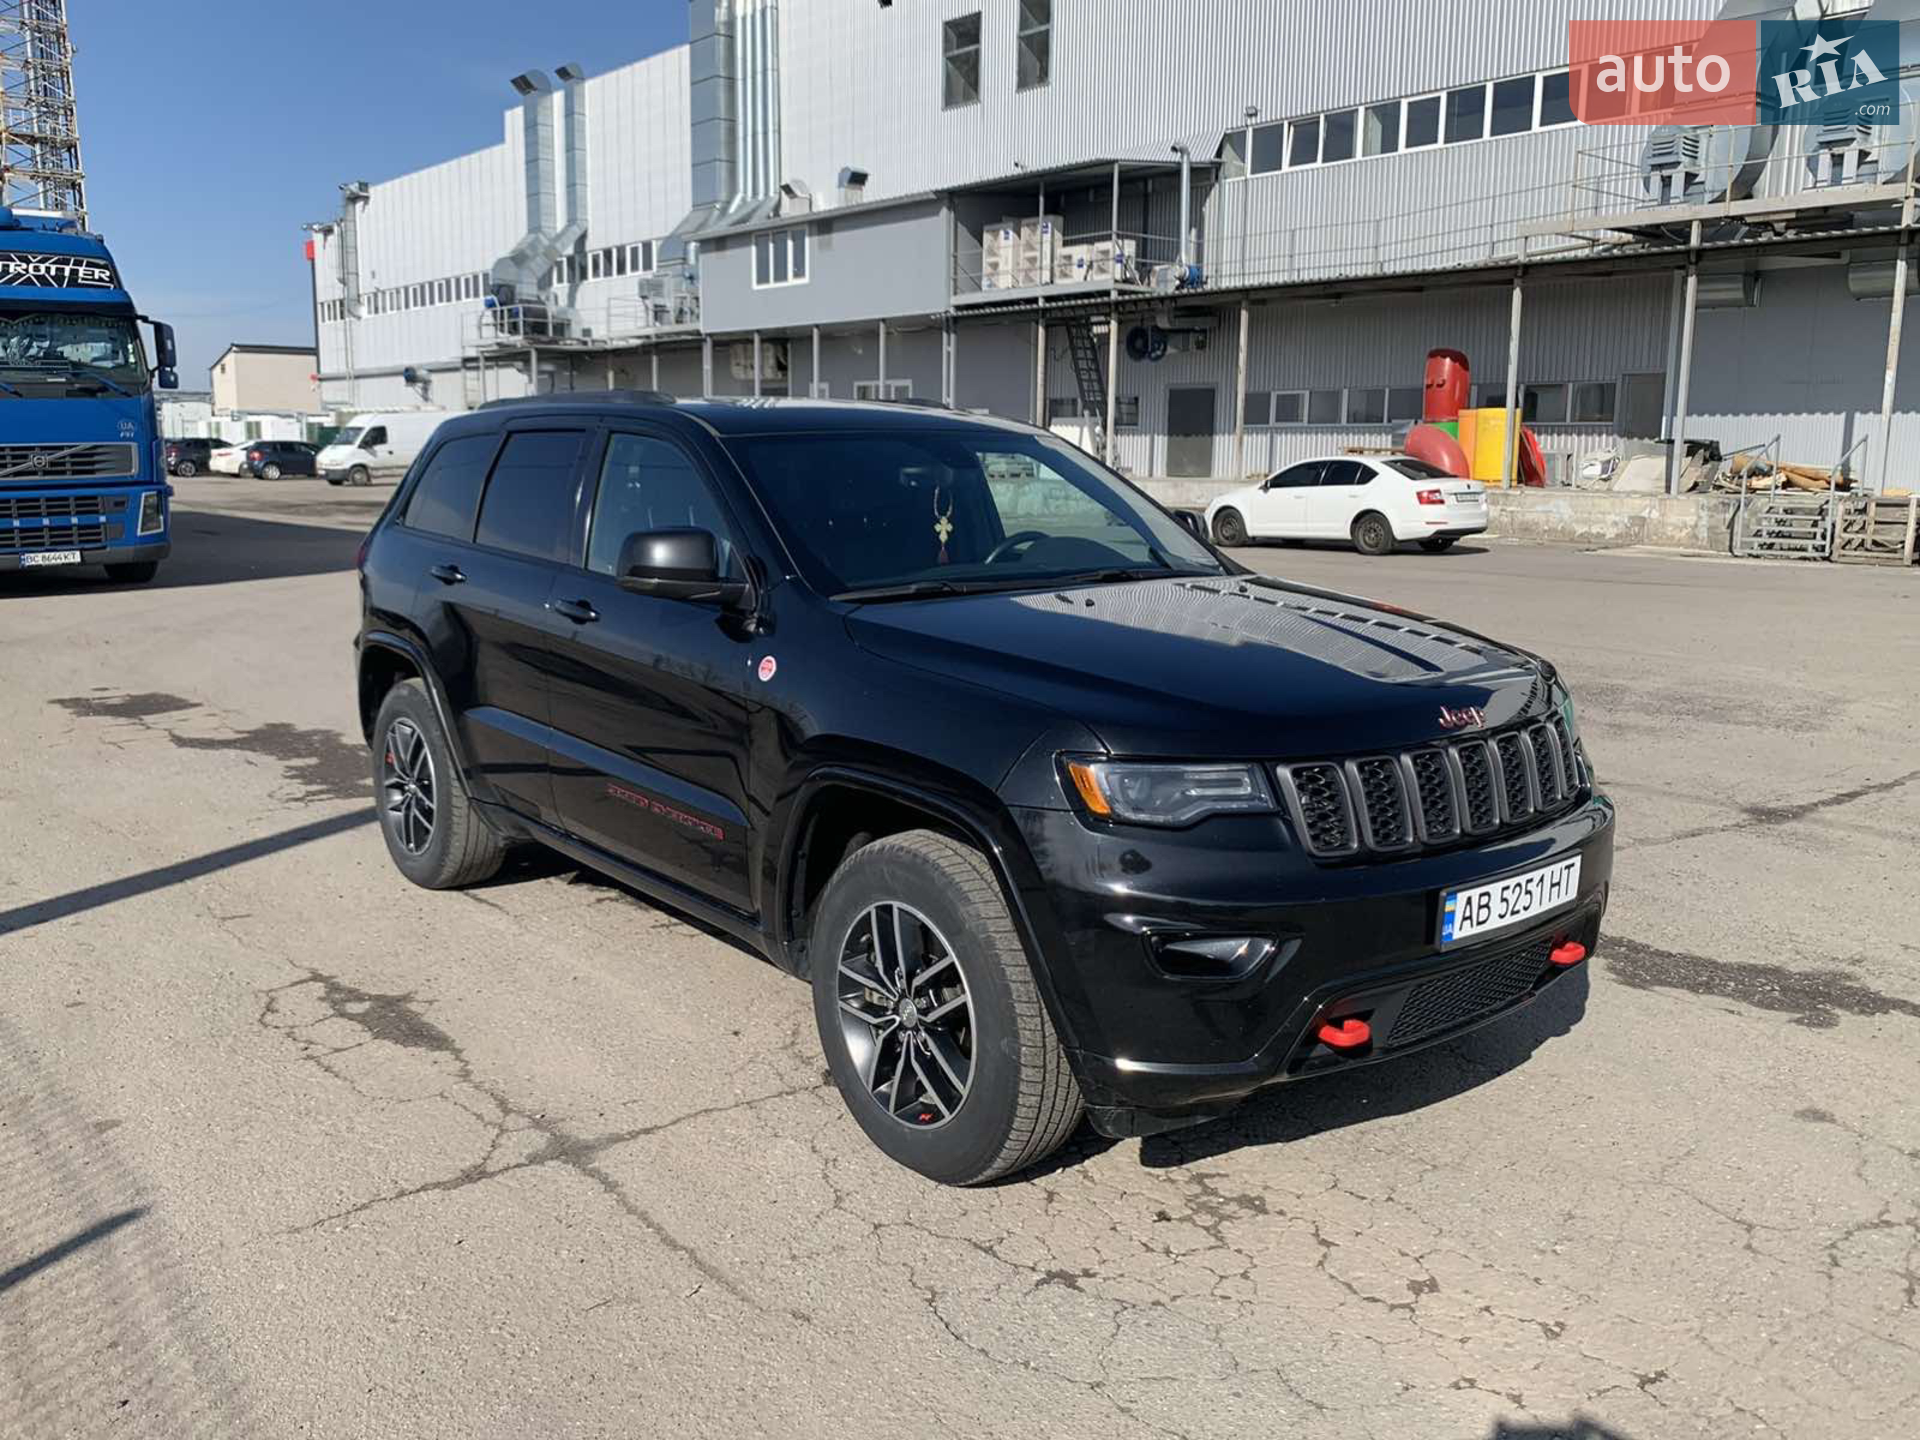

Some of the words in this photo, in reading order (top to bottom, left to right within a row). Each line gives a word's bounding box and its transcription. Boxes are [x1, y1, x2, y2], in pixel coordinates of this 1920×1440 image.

[1438, 705, 1486, 730] Jeep
[1459, 890, 1492, 931] AB
[1498, 873, 1546, 920] 5251
[1549, 862, 1575, 902] HT
